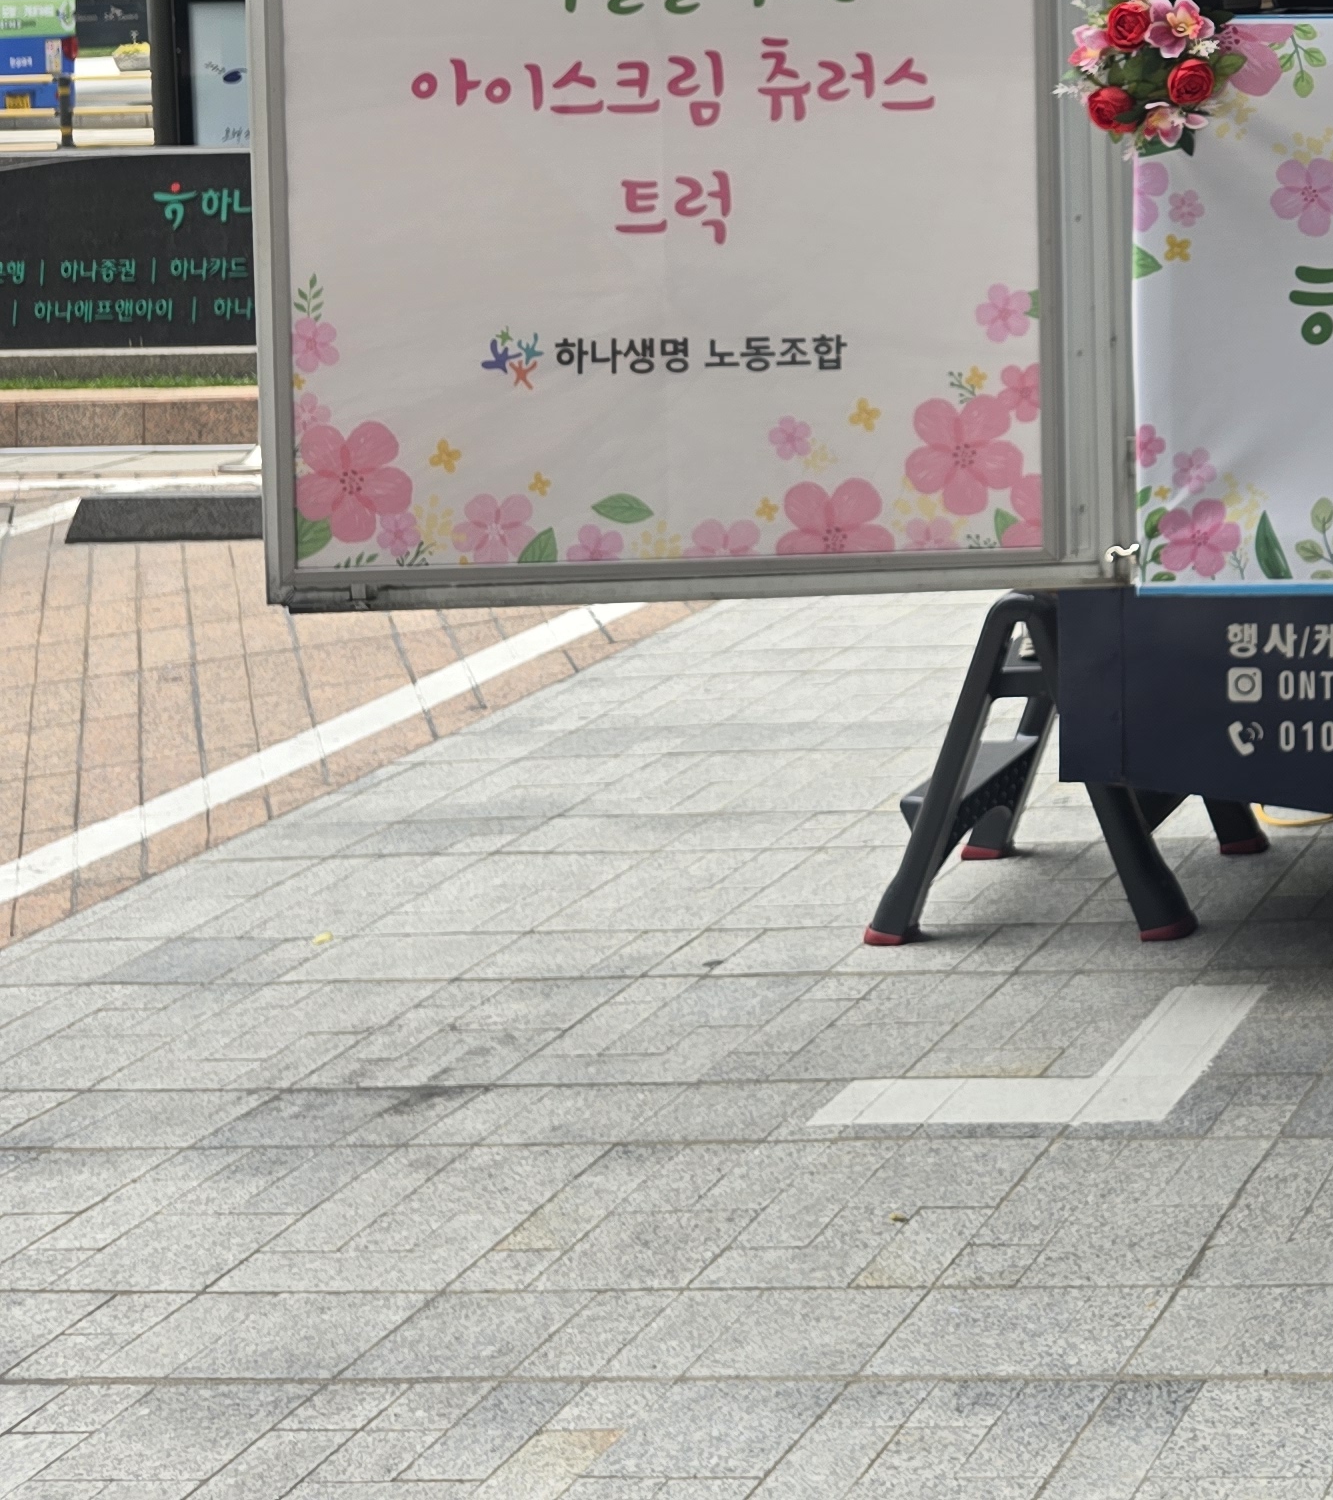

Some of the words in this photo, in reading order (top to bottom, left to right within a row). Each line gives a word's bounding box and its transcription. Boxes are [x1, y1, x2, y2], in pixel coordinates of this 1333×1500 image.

[410, 49, 726, 126] 아이스크림
[757, 37, 937, 121] 츄러스
[614, 170, 733, 245] 트럭
[60, 260, 136, 283] 하나증권
[169, 257, 249, 281] 하나카드
[34, 299, 173, 324] 하나에프앤아이
[554, 337, 691, 375] 하나생명
[704, 334, 849, 372] 노동조합
